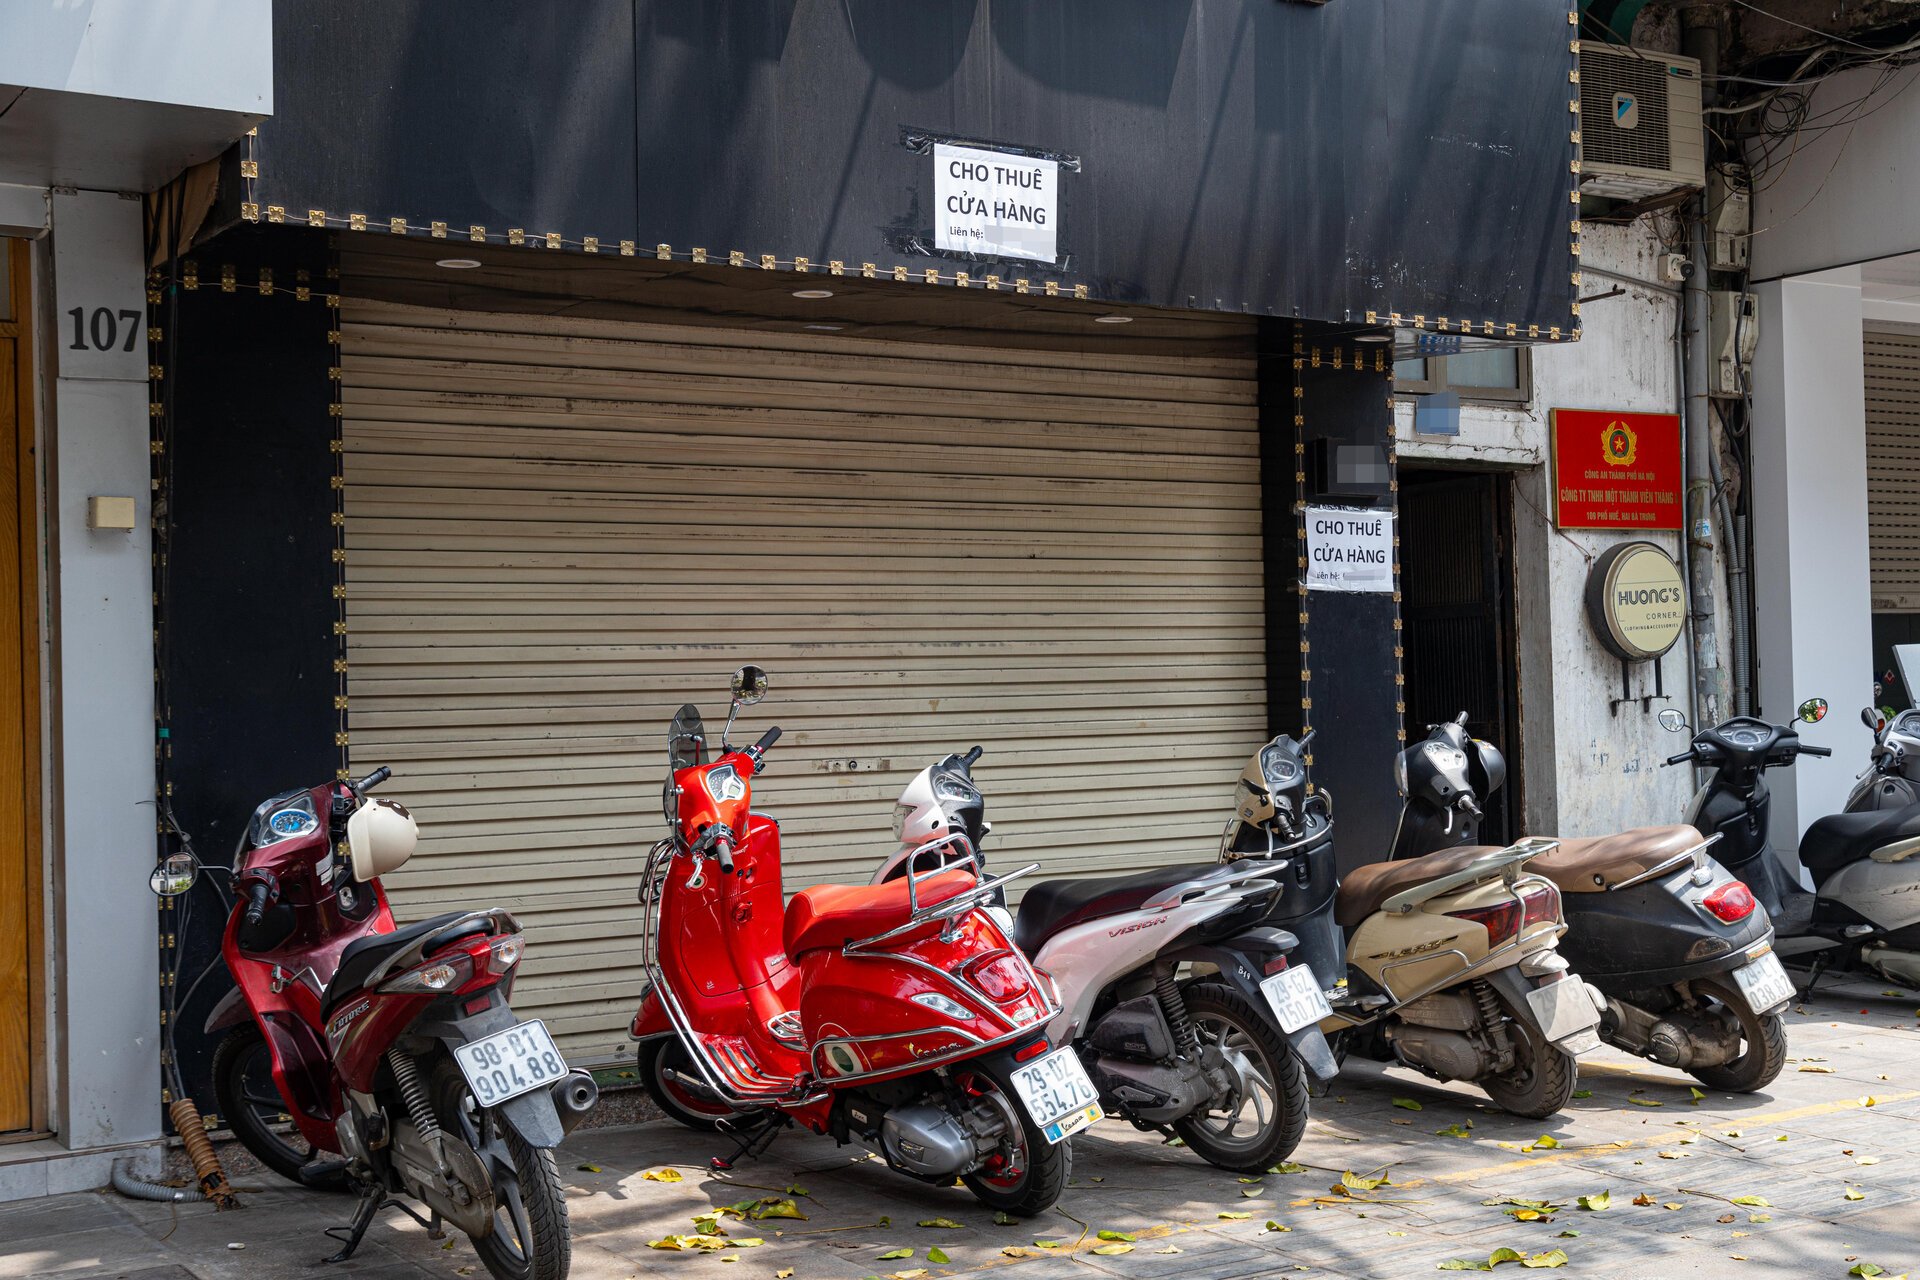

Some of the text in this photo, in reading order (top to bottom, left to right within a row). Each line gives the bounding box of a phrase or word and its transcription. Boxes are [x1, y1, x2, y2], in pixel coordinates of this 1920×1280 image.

[949, 161, 1042, 190] CHO THUÊ
[947, 190, 1046, 225] CỬA HÀNG
[950, 226, 984, 240] Liên hệ:
[67, 306, 142, 352] 107
[1584, 468, 1599, 479] CÔNG
[1600, 470, 1608, 479] AN
[1560, 486, 1578, 502] CÔNG
[1579, 489, 1586, 502] TY
[1587, 489, 1604, 503] TNHH
[1605, 487, 1618, 505] MỘT
[1619, 488, 1639, 503] THÀNH
[1639, 488, 1654, 504] VIÊN
[1315, 519, 1382, 537] CHO THUÊ
[1597, 508, 1608, 521] PHỐ
[1313, 542, 1385, 564] CỬA HÀNG
[1618, 587, 1681, 606] HUONG'S
[1646, 611, 1677, 620] CORNER
[1108, 915, 1168, 938] VISION
[1270, 971, 1312, 1004] 29-G2
[1749, 974, 1793, 1010] 038.82
[1279, 992, 1328, 1028] 150.74
[471, 1028, 538, 1071] 98-B1
[476, 1051, 561, 1100] 904.88
[1022, 1054, 1074, 1096] 29-D2
[1030, 1077, 1092, 1122] 554.76
